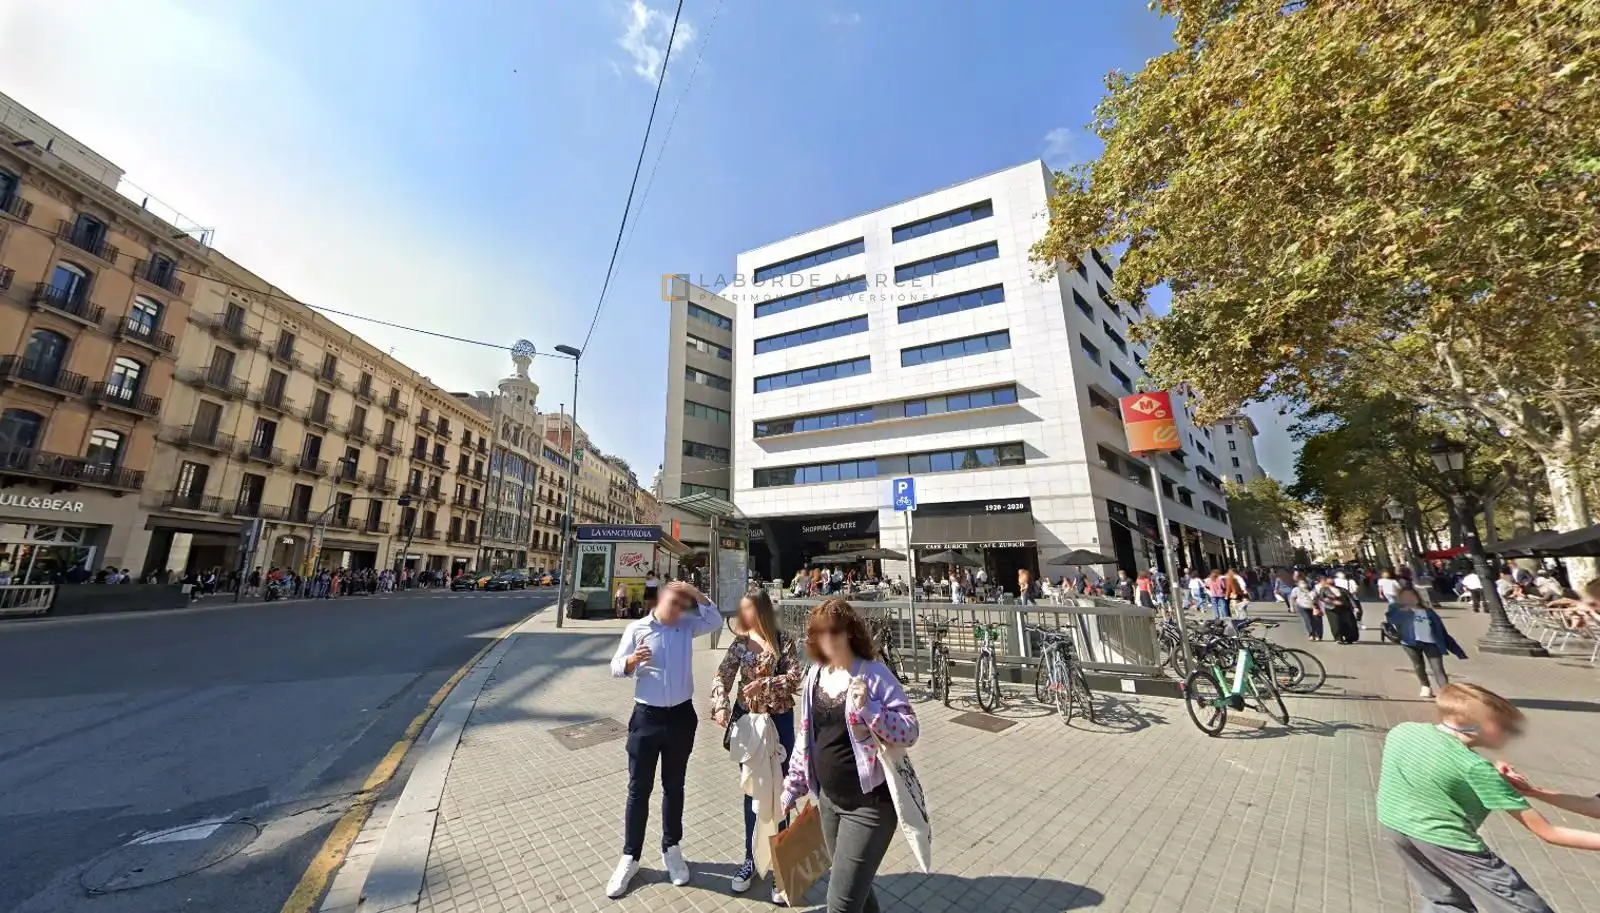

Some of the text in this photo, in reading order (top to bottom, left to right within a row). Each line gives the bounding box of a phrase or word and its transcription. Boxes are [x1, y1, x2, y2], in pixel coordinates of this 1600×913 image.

[898, 481, 908, 494] P
[591, 528, 652, 538] LA VANGUARDIA
[581, 544, 608, 553] LOEWE
